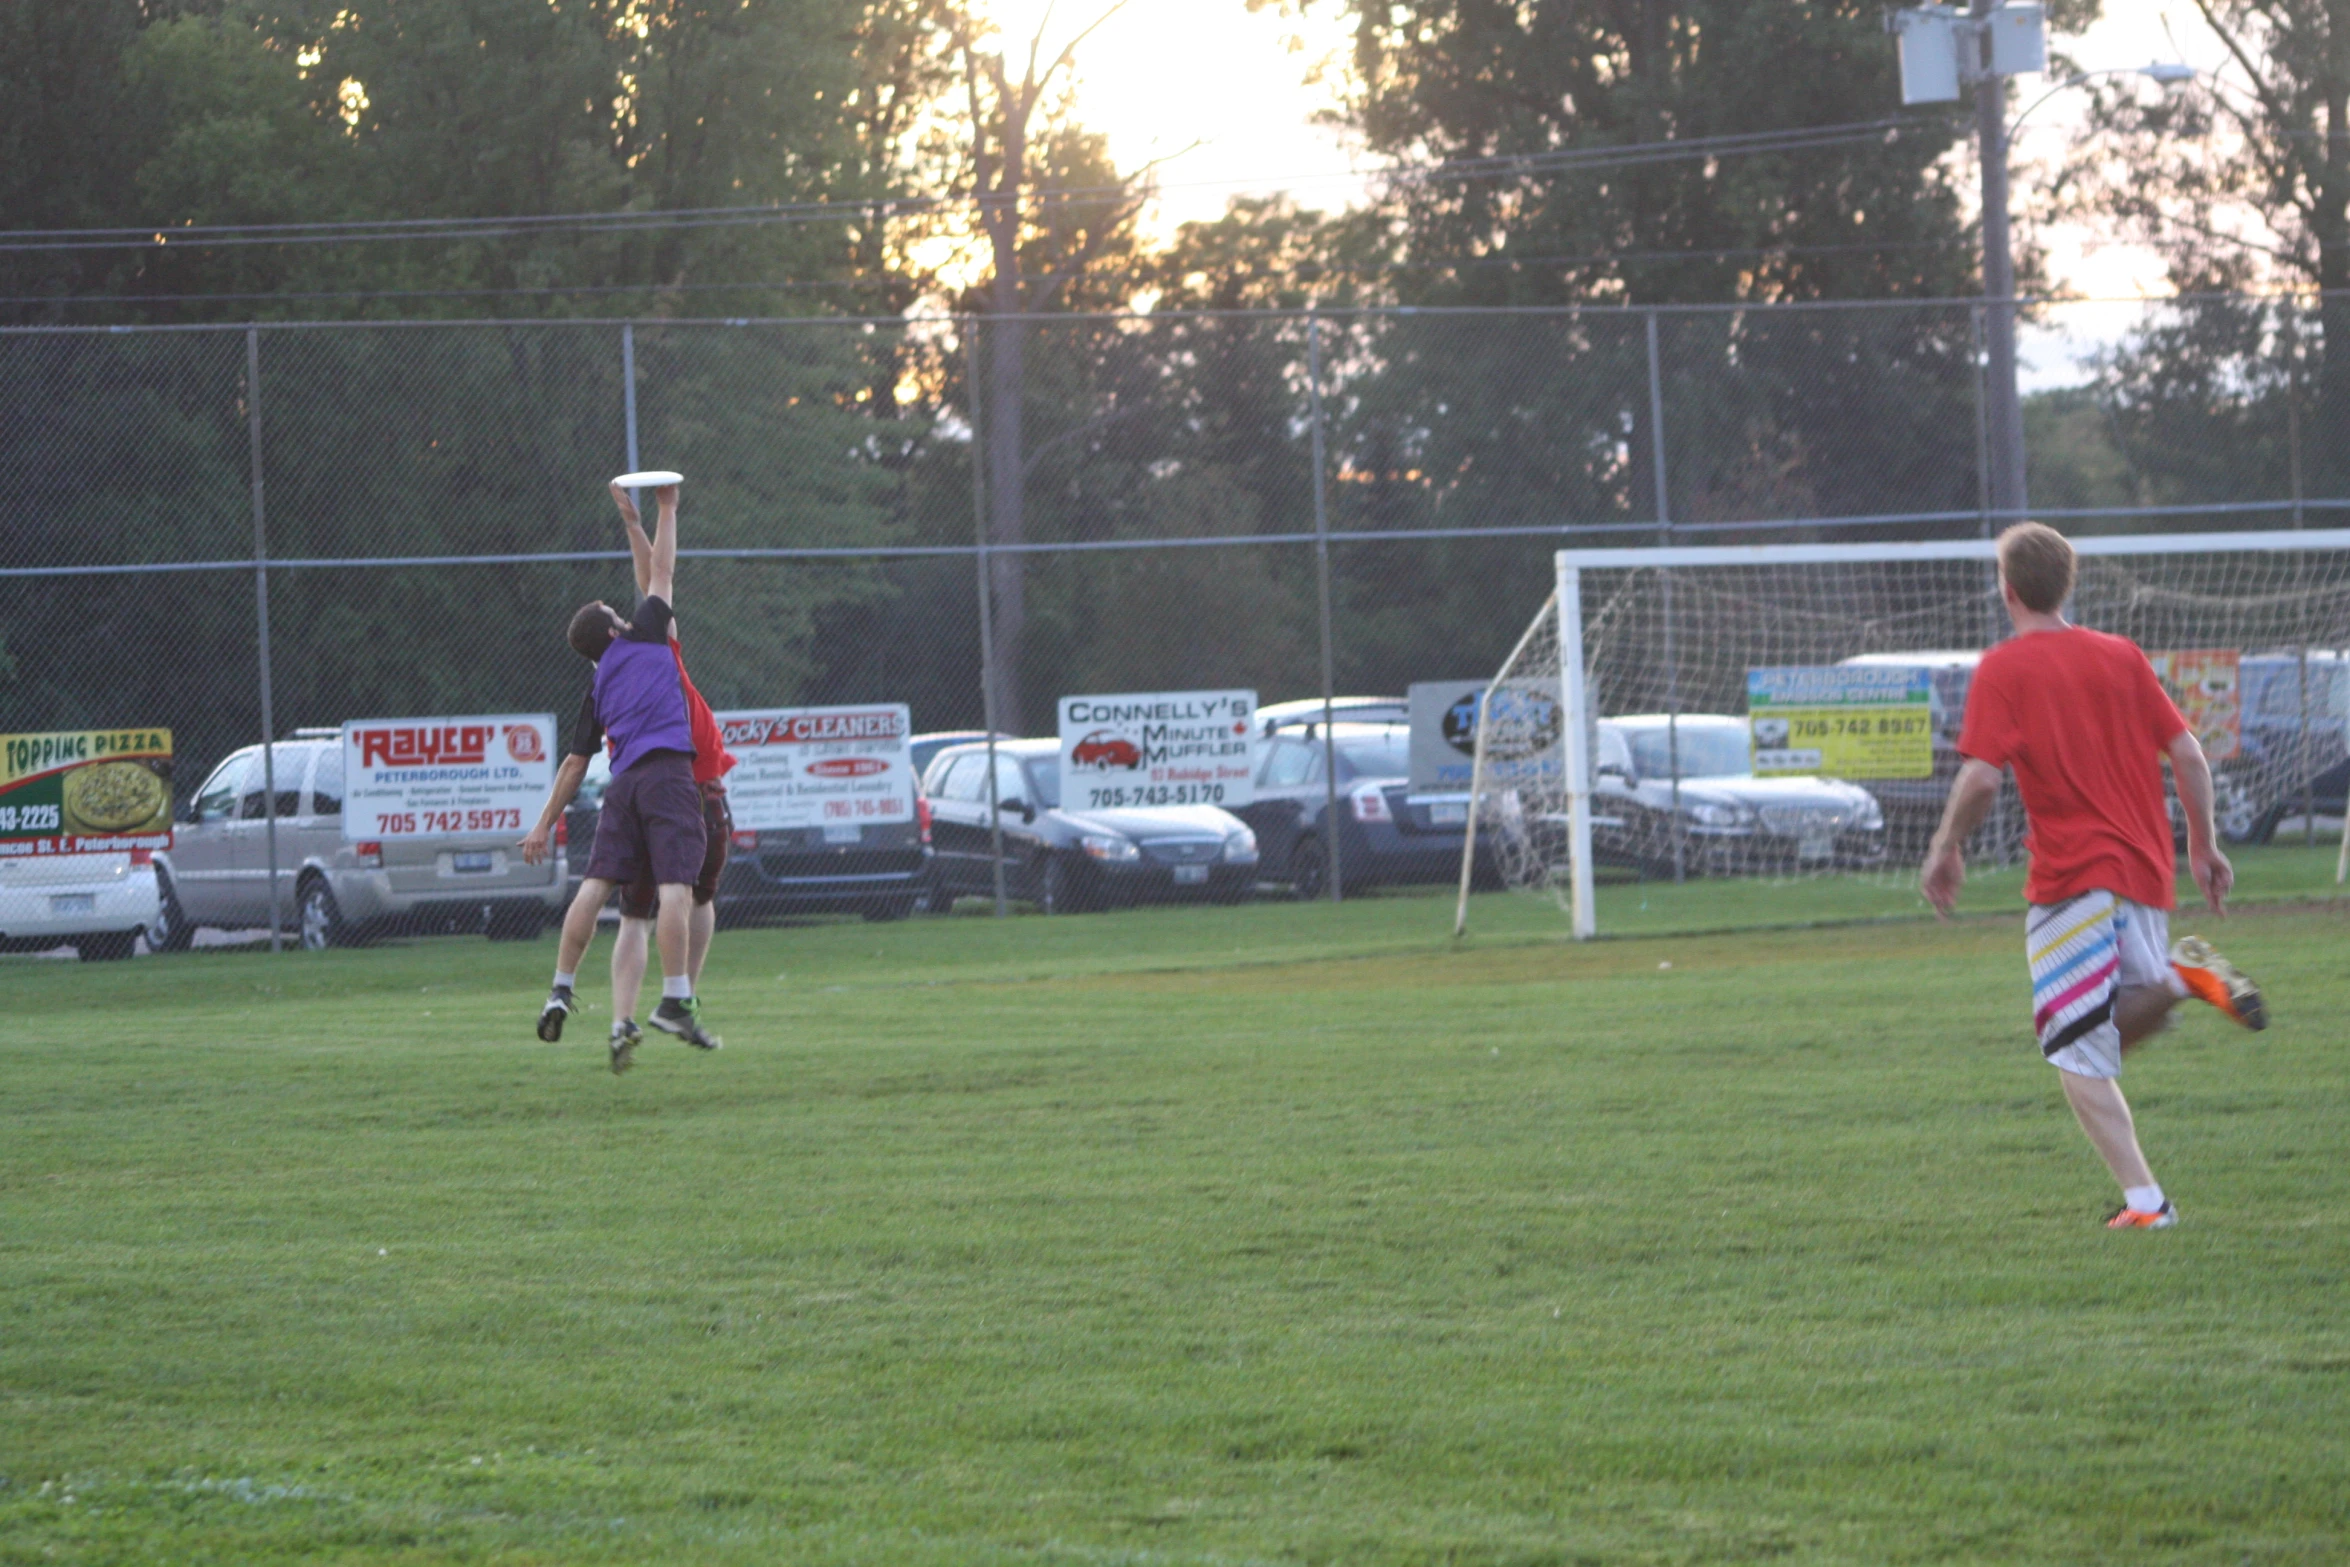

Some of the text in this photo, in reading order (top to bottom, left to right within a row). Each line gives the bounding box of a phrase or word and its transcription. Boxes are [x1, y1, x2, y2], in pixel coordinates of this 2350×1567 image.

[1068, 697, 1249, 724] CONNELLY'S
[793, 714, 906, 740] CLEANERS
[1144, 723, 1229, 744] MINUTE
[7, 733, 163, 774] TOPPING PIZZA
[1144, 742, 1247, 767] MUFFLER
[374, 767, 523, 784] PETERBOROUGH LTD.
[1090, 783, 1226, 807] 705-743-5170
[377, 808, 522, 834] 705 742 5973
[75, 836, 169, 852] Peterborough
